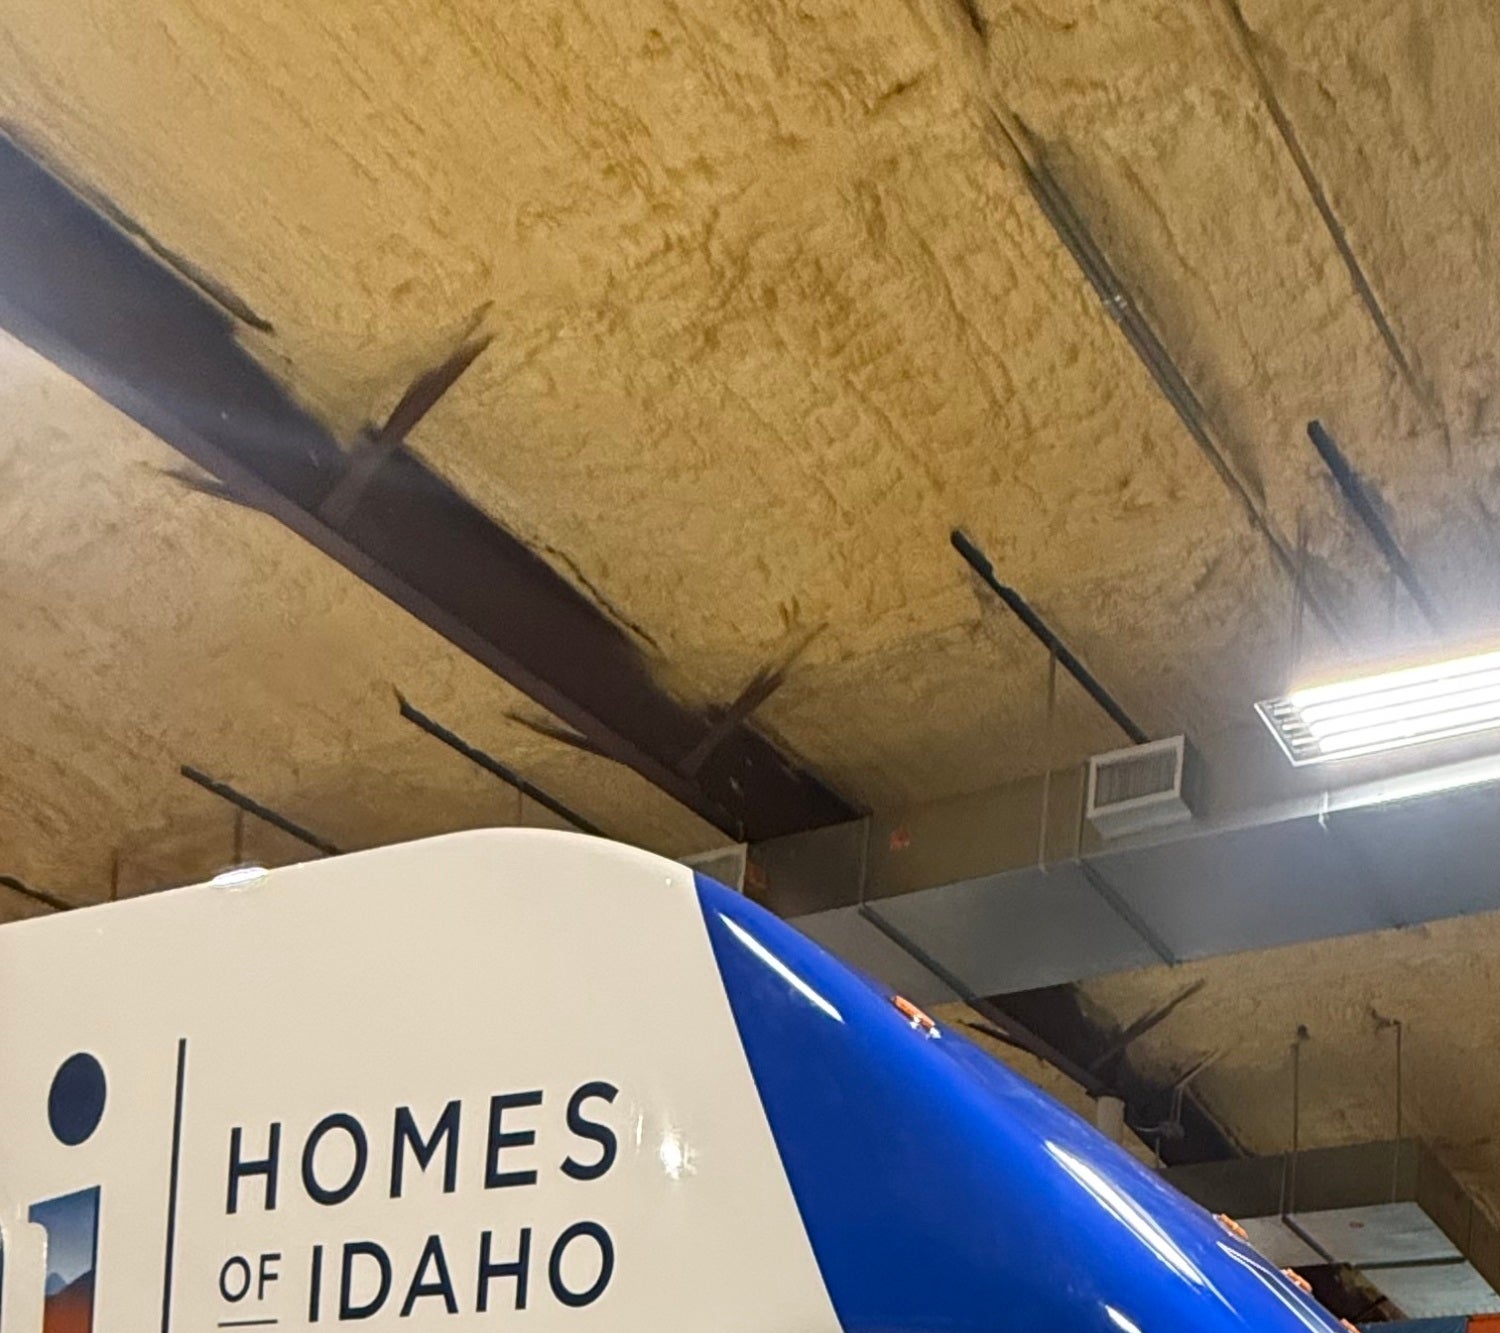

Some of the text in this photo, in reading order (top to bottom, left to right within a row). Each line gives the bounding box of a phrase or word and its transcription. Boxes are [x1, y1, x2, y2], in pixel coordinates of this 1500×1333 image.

[226, 1081, 619, 1215] HOMES
[218, 1221, 615, 1323] OF IDAHO
